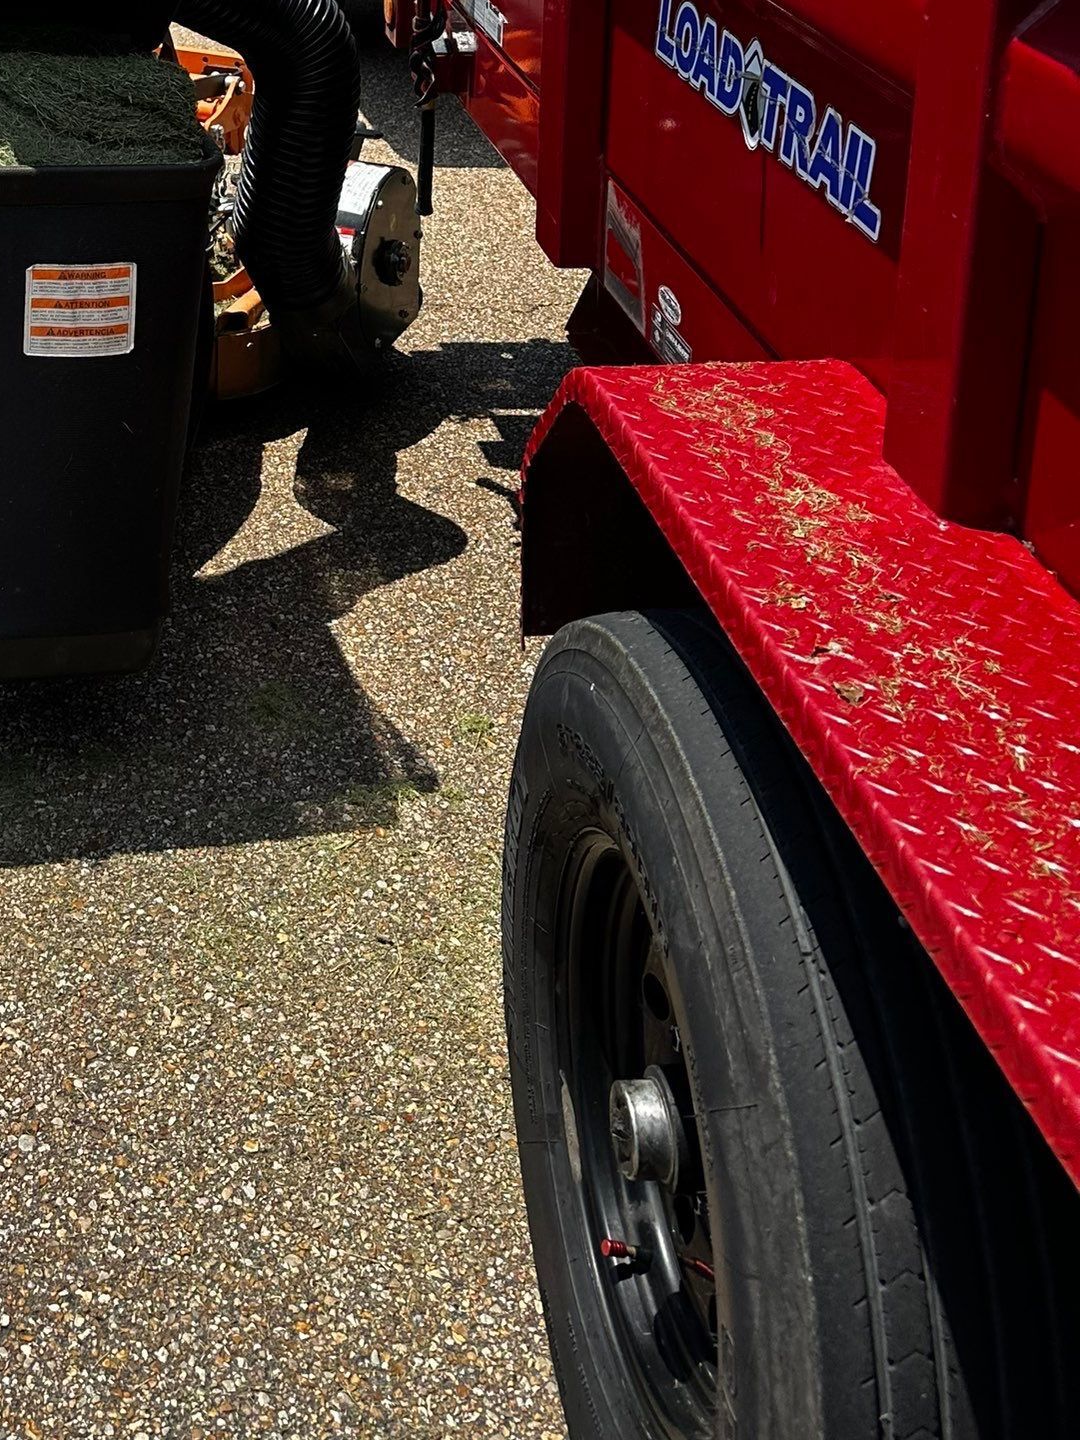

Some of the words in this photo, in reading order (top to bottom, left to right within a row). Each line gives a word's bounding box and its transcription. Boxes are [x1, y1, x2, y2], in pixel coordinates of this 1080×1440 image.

[760, 58, 881, 242] TRAIL
[66, 271, 107, 280] WARNING
[65, 300, 111, 309] ATTENTION
[57, 327, 115, 337] ADVERTENCIA
